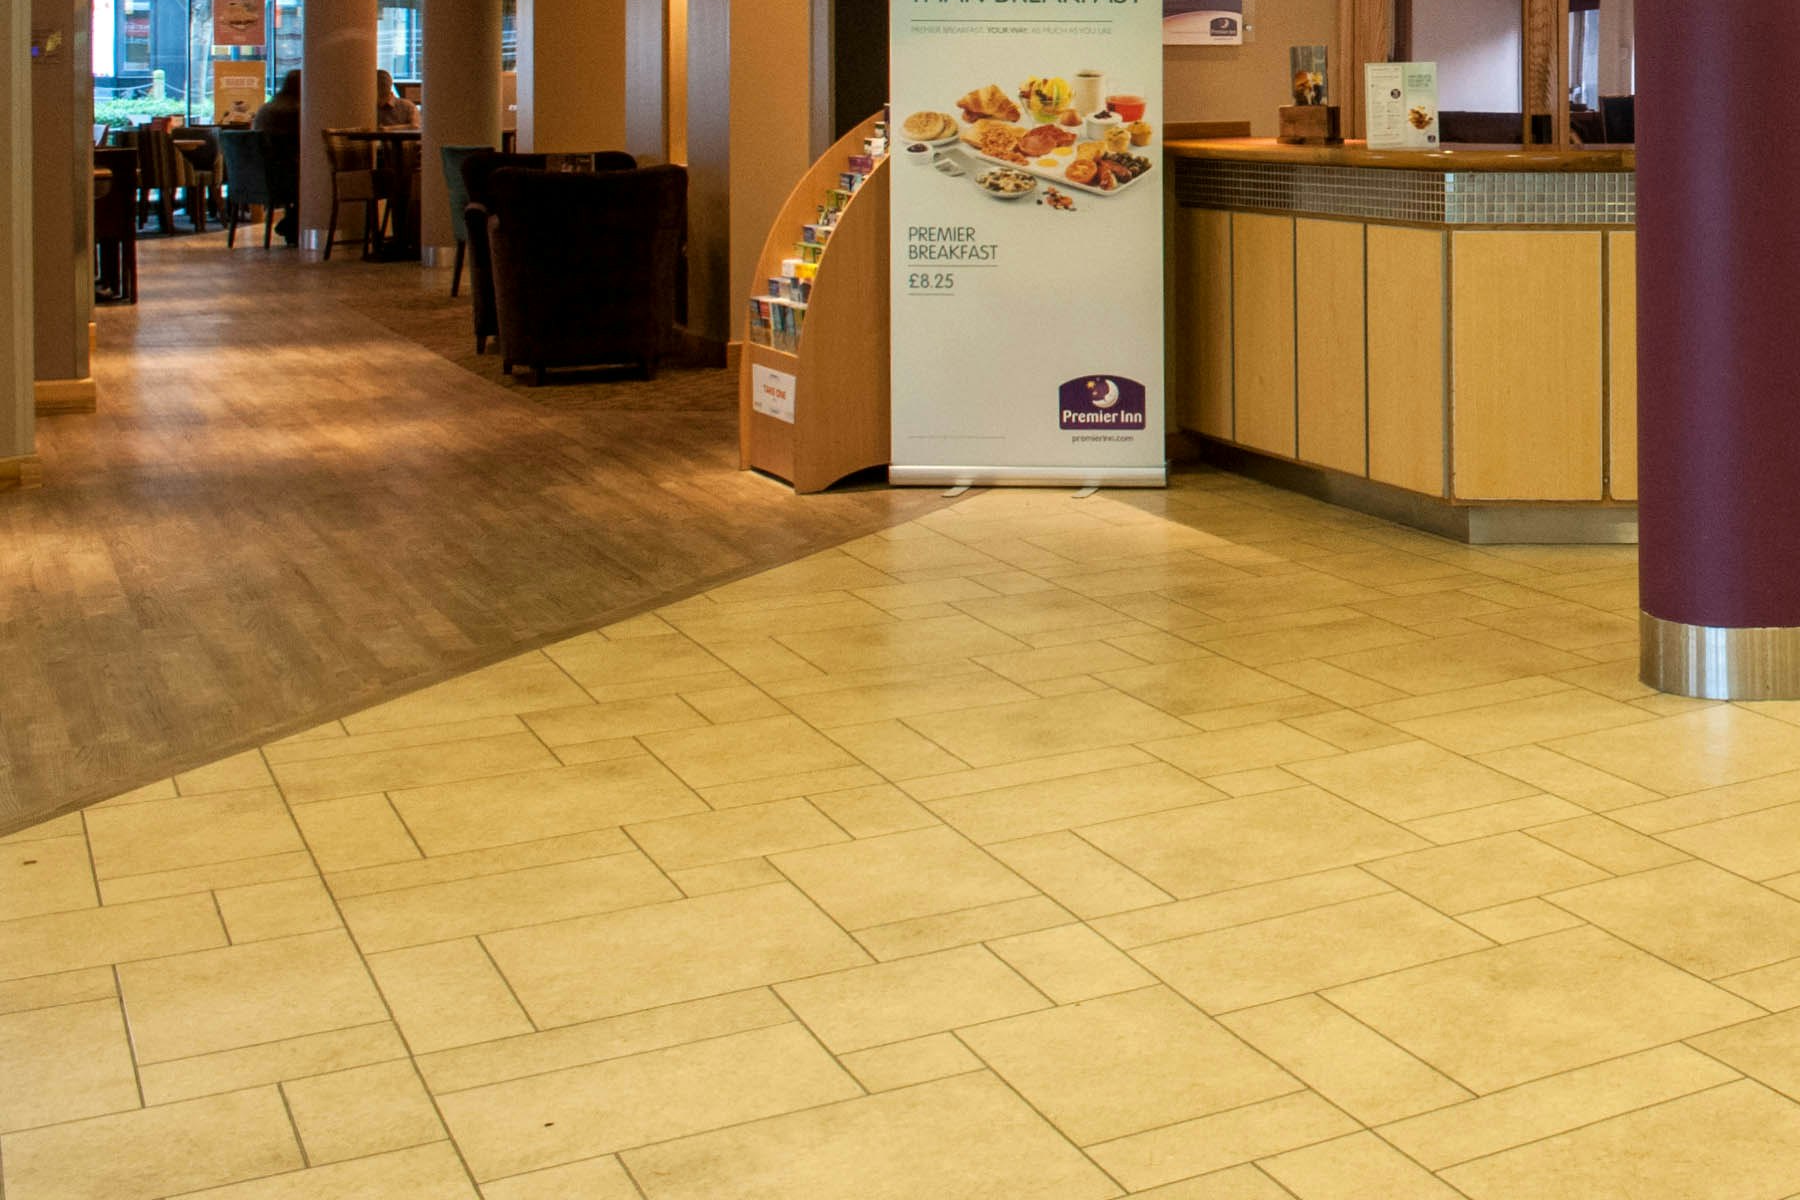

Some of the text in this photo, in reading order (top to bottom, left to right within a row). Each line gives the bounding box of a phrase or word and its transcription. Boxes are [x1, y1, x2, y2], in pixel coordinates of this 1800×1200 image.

[908, 226, 976, 242] PREMIER
[908, 244, 998, 260] BREAKFAST
[908, 272, 954, 289] £8.25
[1062, 409, 1142, 423] Premier Inn
